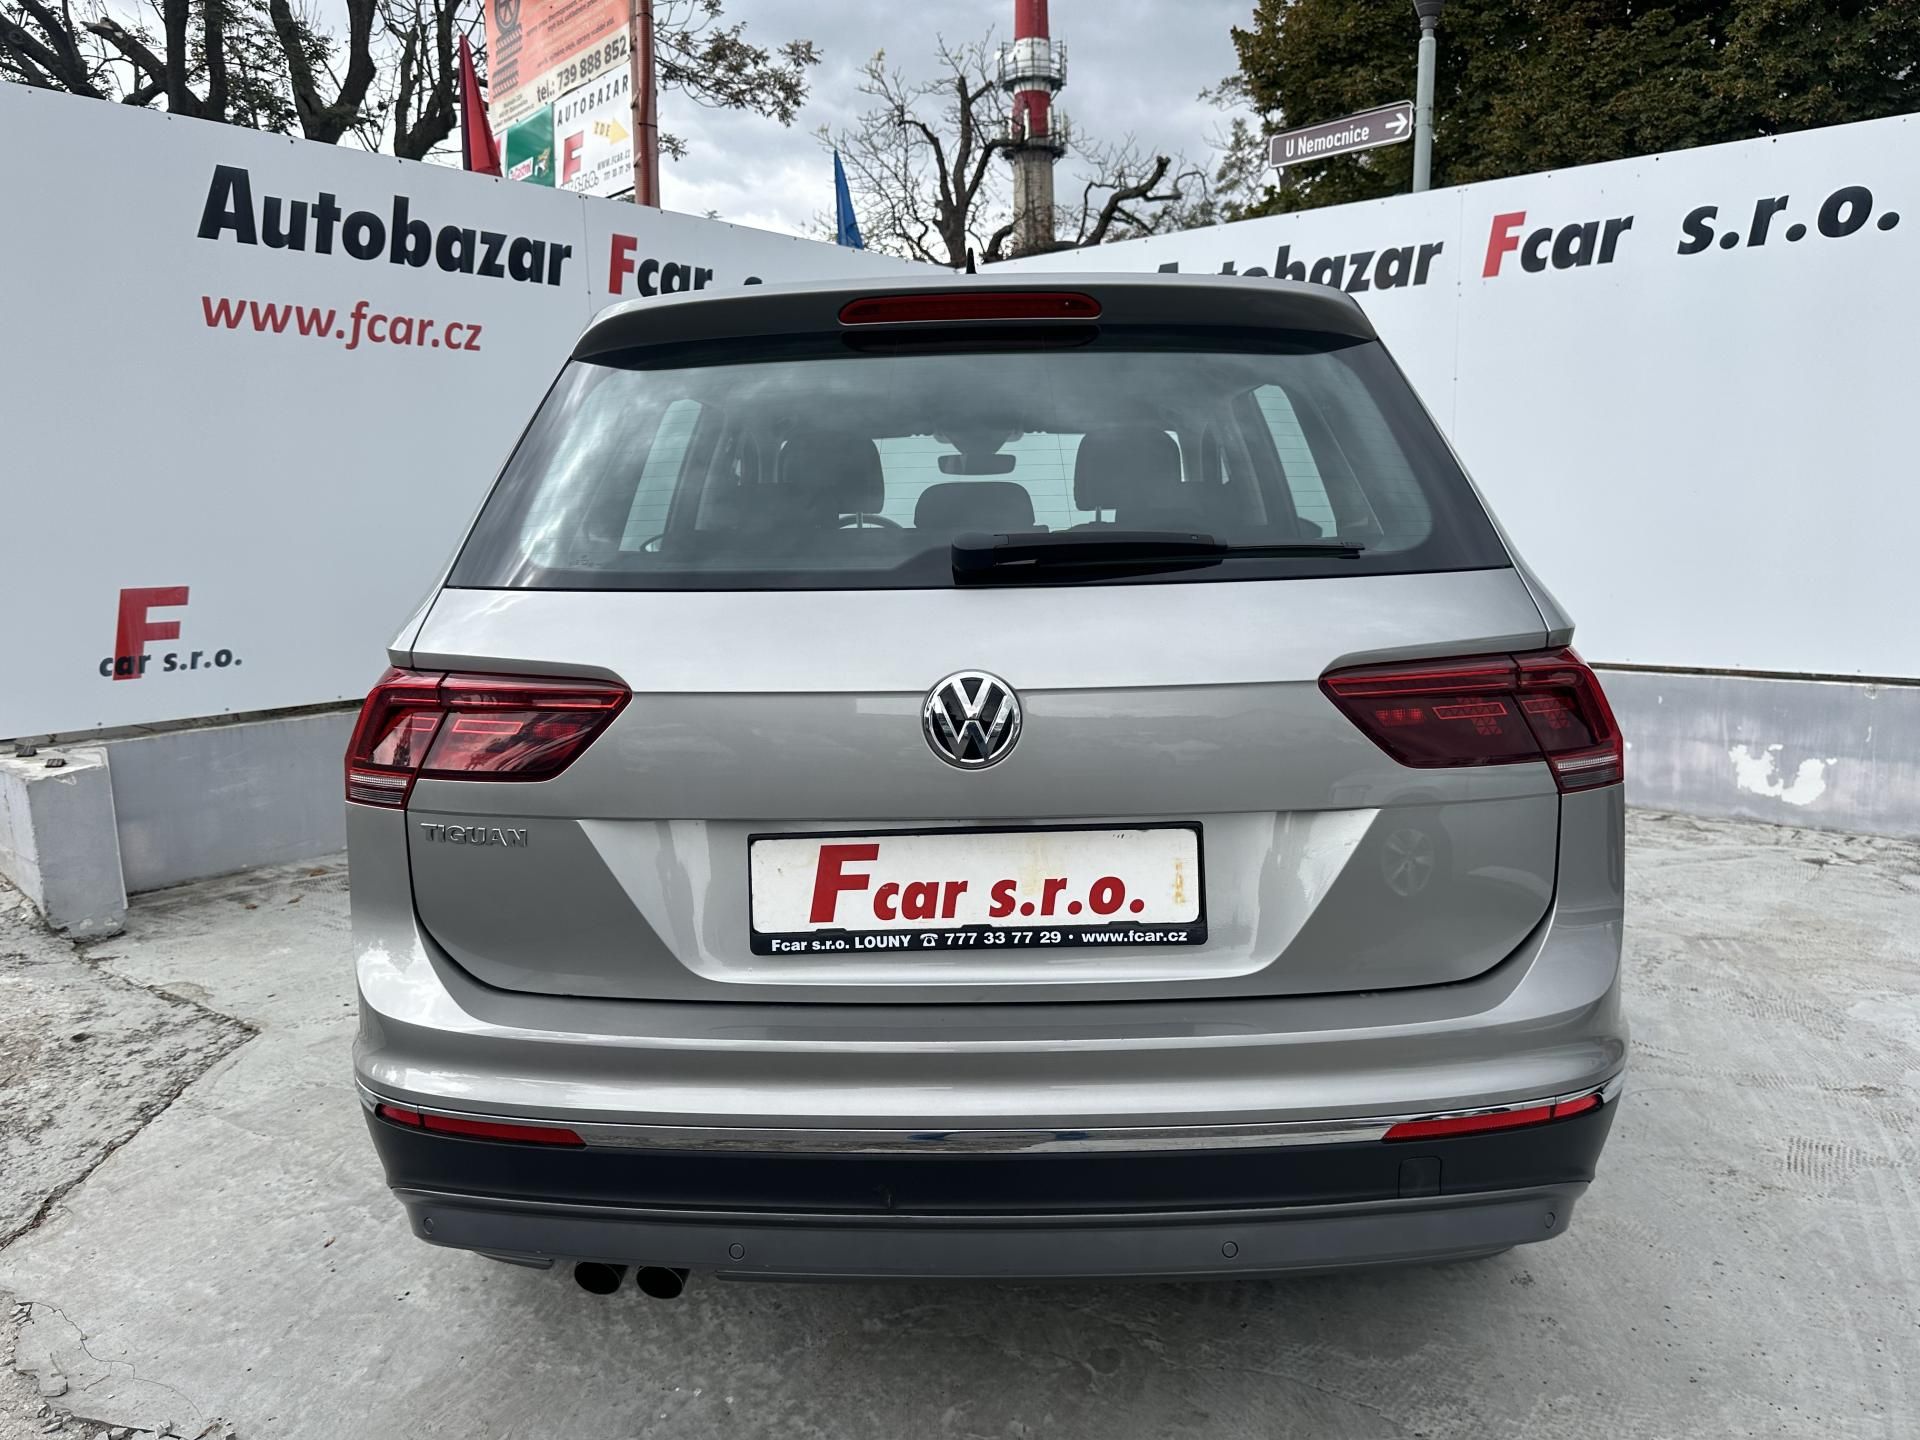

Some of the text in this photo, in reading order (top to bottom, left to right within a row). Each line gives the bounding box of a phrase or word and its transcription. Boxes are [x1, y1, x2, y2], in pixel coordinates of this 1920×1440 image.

[537, 80, 556, 103] tel.:
[557, 66, 577, 91] 739
[580, 54, 601, 79] 888
[604, 35, 628, 64] 852
[557, 74, 628, 127] AUTOBAZAR
[1286, 124, 1370, 157] U Nemocnice
[198, 164, 713, 297] Autobazar Fcar
[1158, 186, 1901, 293] bazar Fcar s.r.o.
[201, 296, 482, 351] www.fcar.cz
[163, 649, 242, 672] s.r.o.
[420, 823, 528, 848] TIGUAN
[809, 843, 1145, 924] Fcar s.r.o.
[771, 930, 1188, 952] Fcar s.r.o. LOUNY 777 33 77 29 www.fcar.cz
